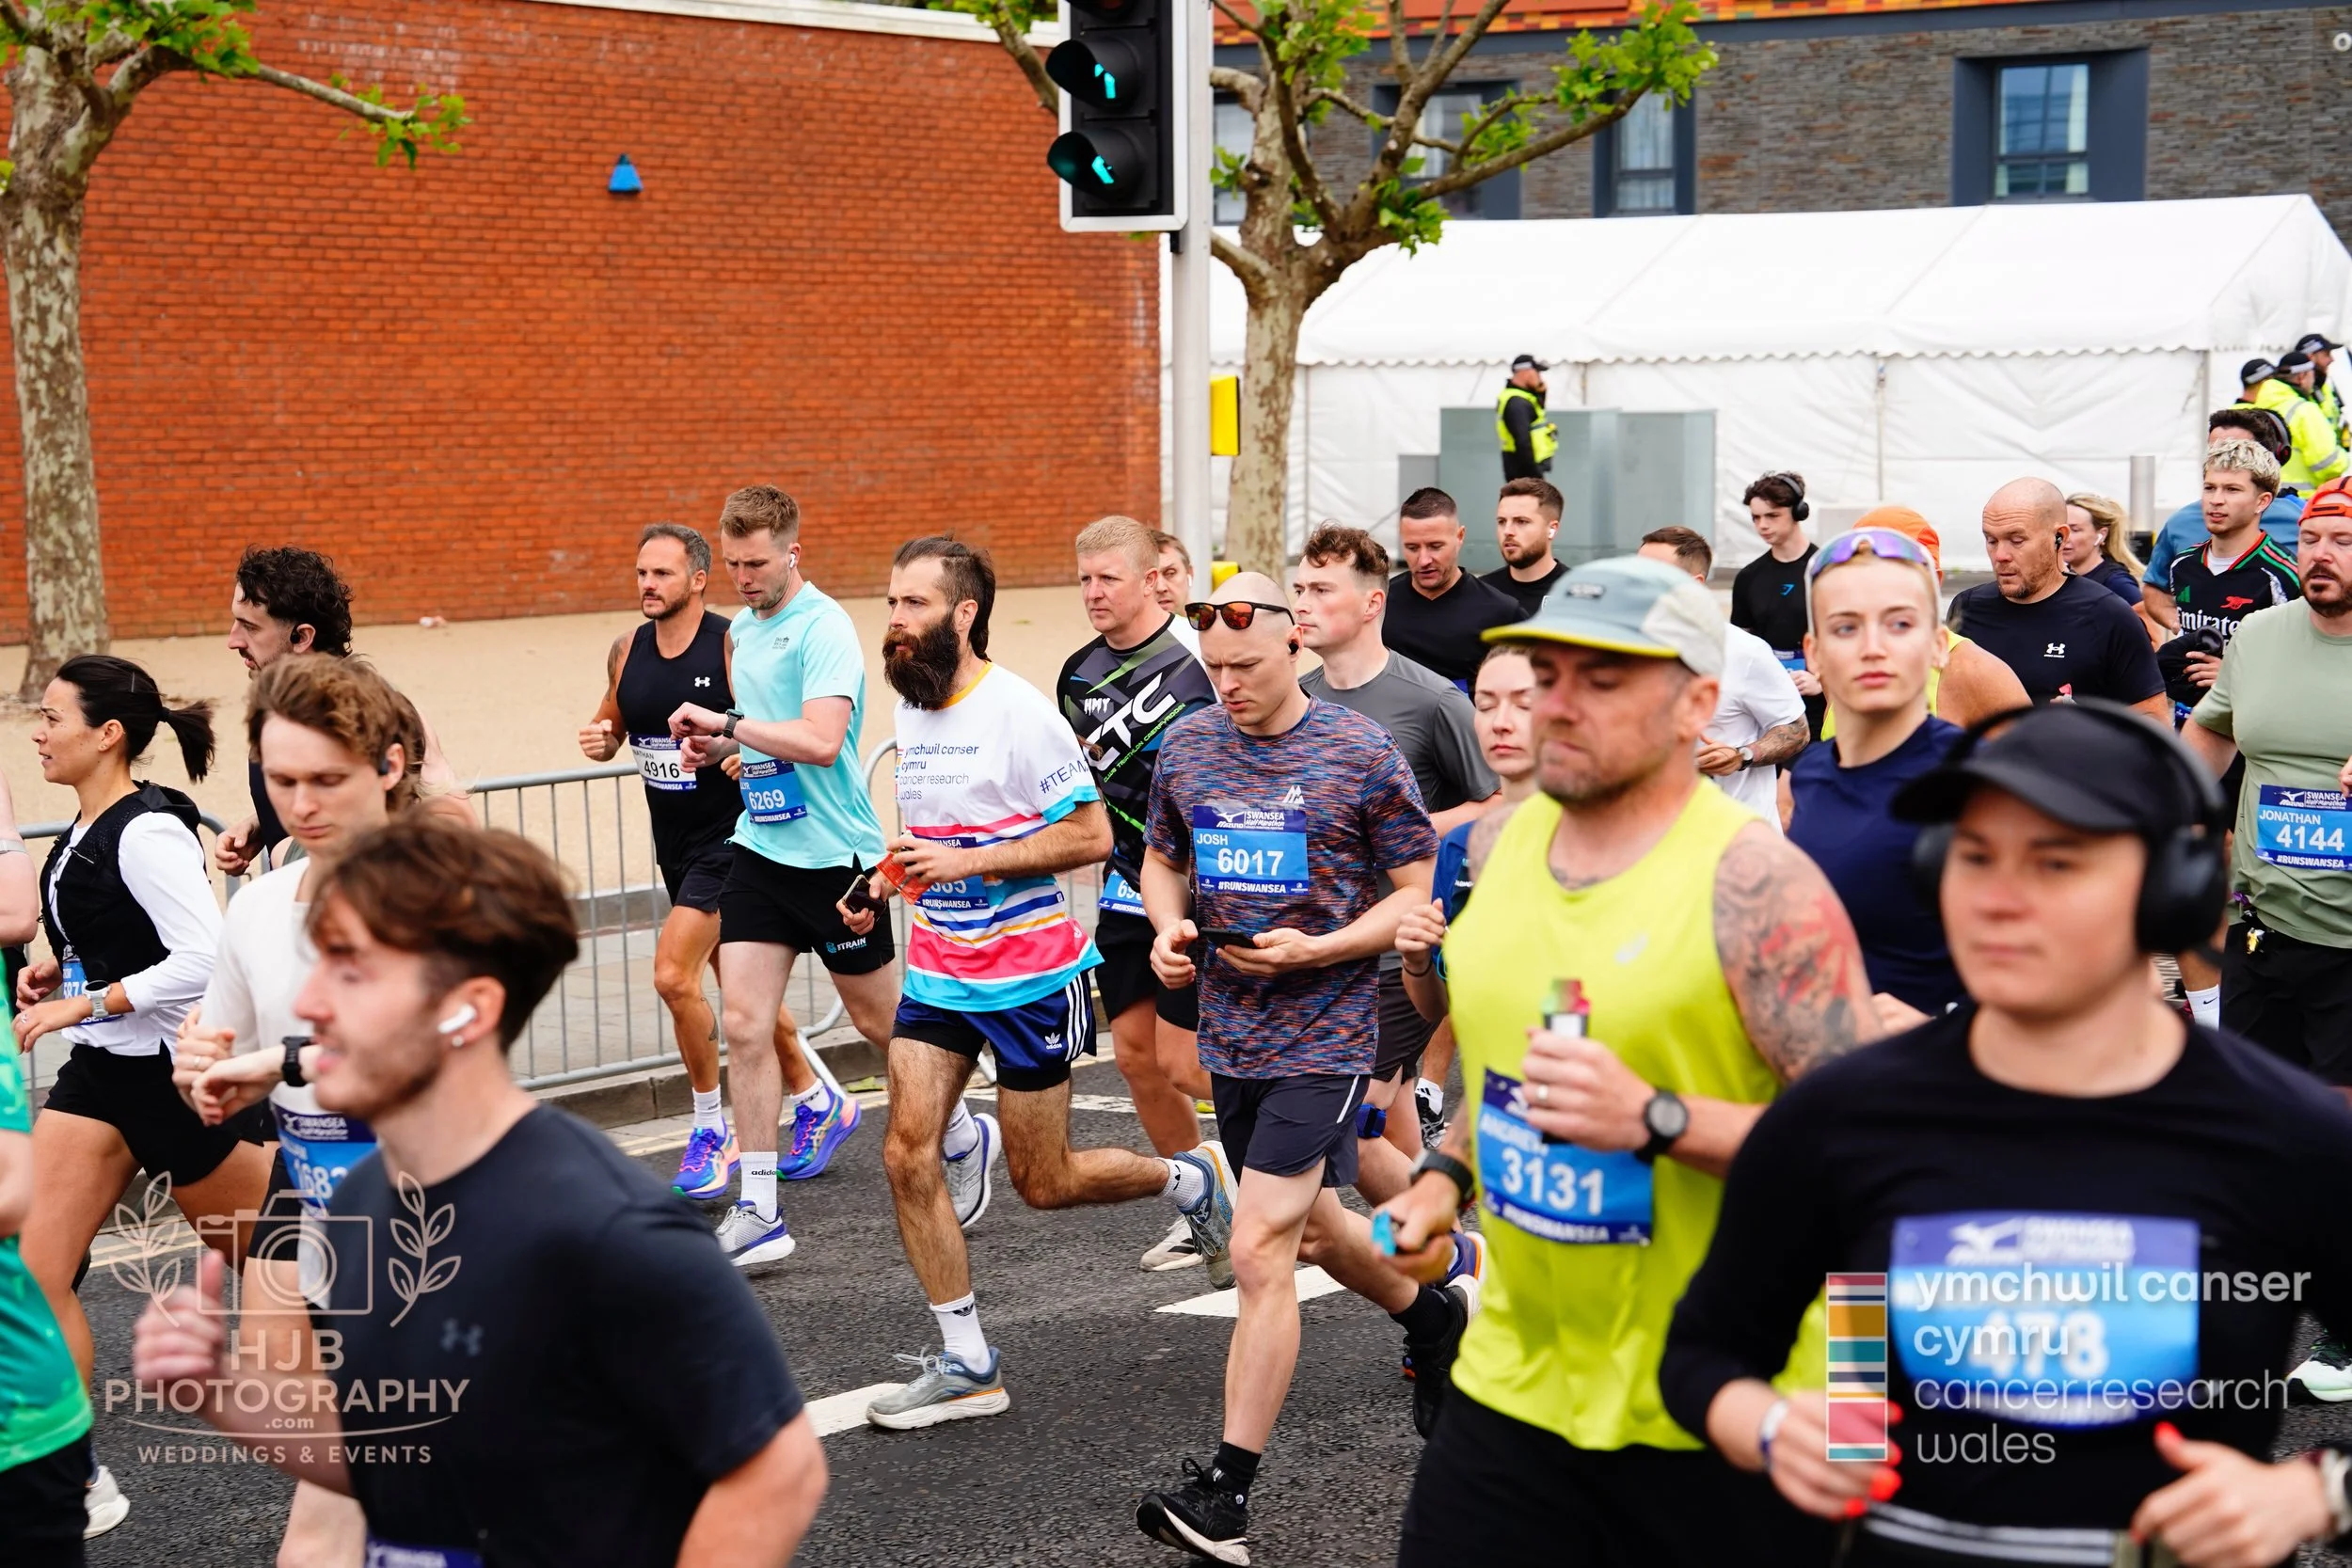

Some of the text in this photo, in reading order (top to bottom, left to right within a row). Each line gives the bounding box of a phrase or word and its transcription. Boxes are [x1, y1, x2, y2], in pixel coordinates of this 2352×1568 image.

[1084, 697, 1111, 716] HMY
[904, 743, 979, 758] ymchwil canser
[644, 760, 680, 778] 4916
[901, 760, 927, 772] cymru
[899, 773, 969, 784] cancer research
[748, 789, 786, 810] 6269
[899, 788, 922, 800] wales
[2306, 791, 2346, 800] SWANSEA
[1247, 811, 1285, 820] SWANSEA
[2259, 810, 2321, 825] JONATHAN
[1197, 833, 1229, 846] JOSH
[2276, 824, 2345, 851] 4144
[1217, 847, 1284, 877] 6017
[2277, 854, 2344, 868] #RUNSWANSEA
[1218, 881, 1286, 894] #RUNSWANSEA
[1501, 1147, 1605, 1216] 3131
